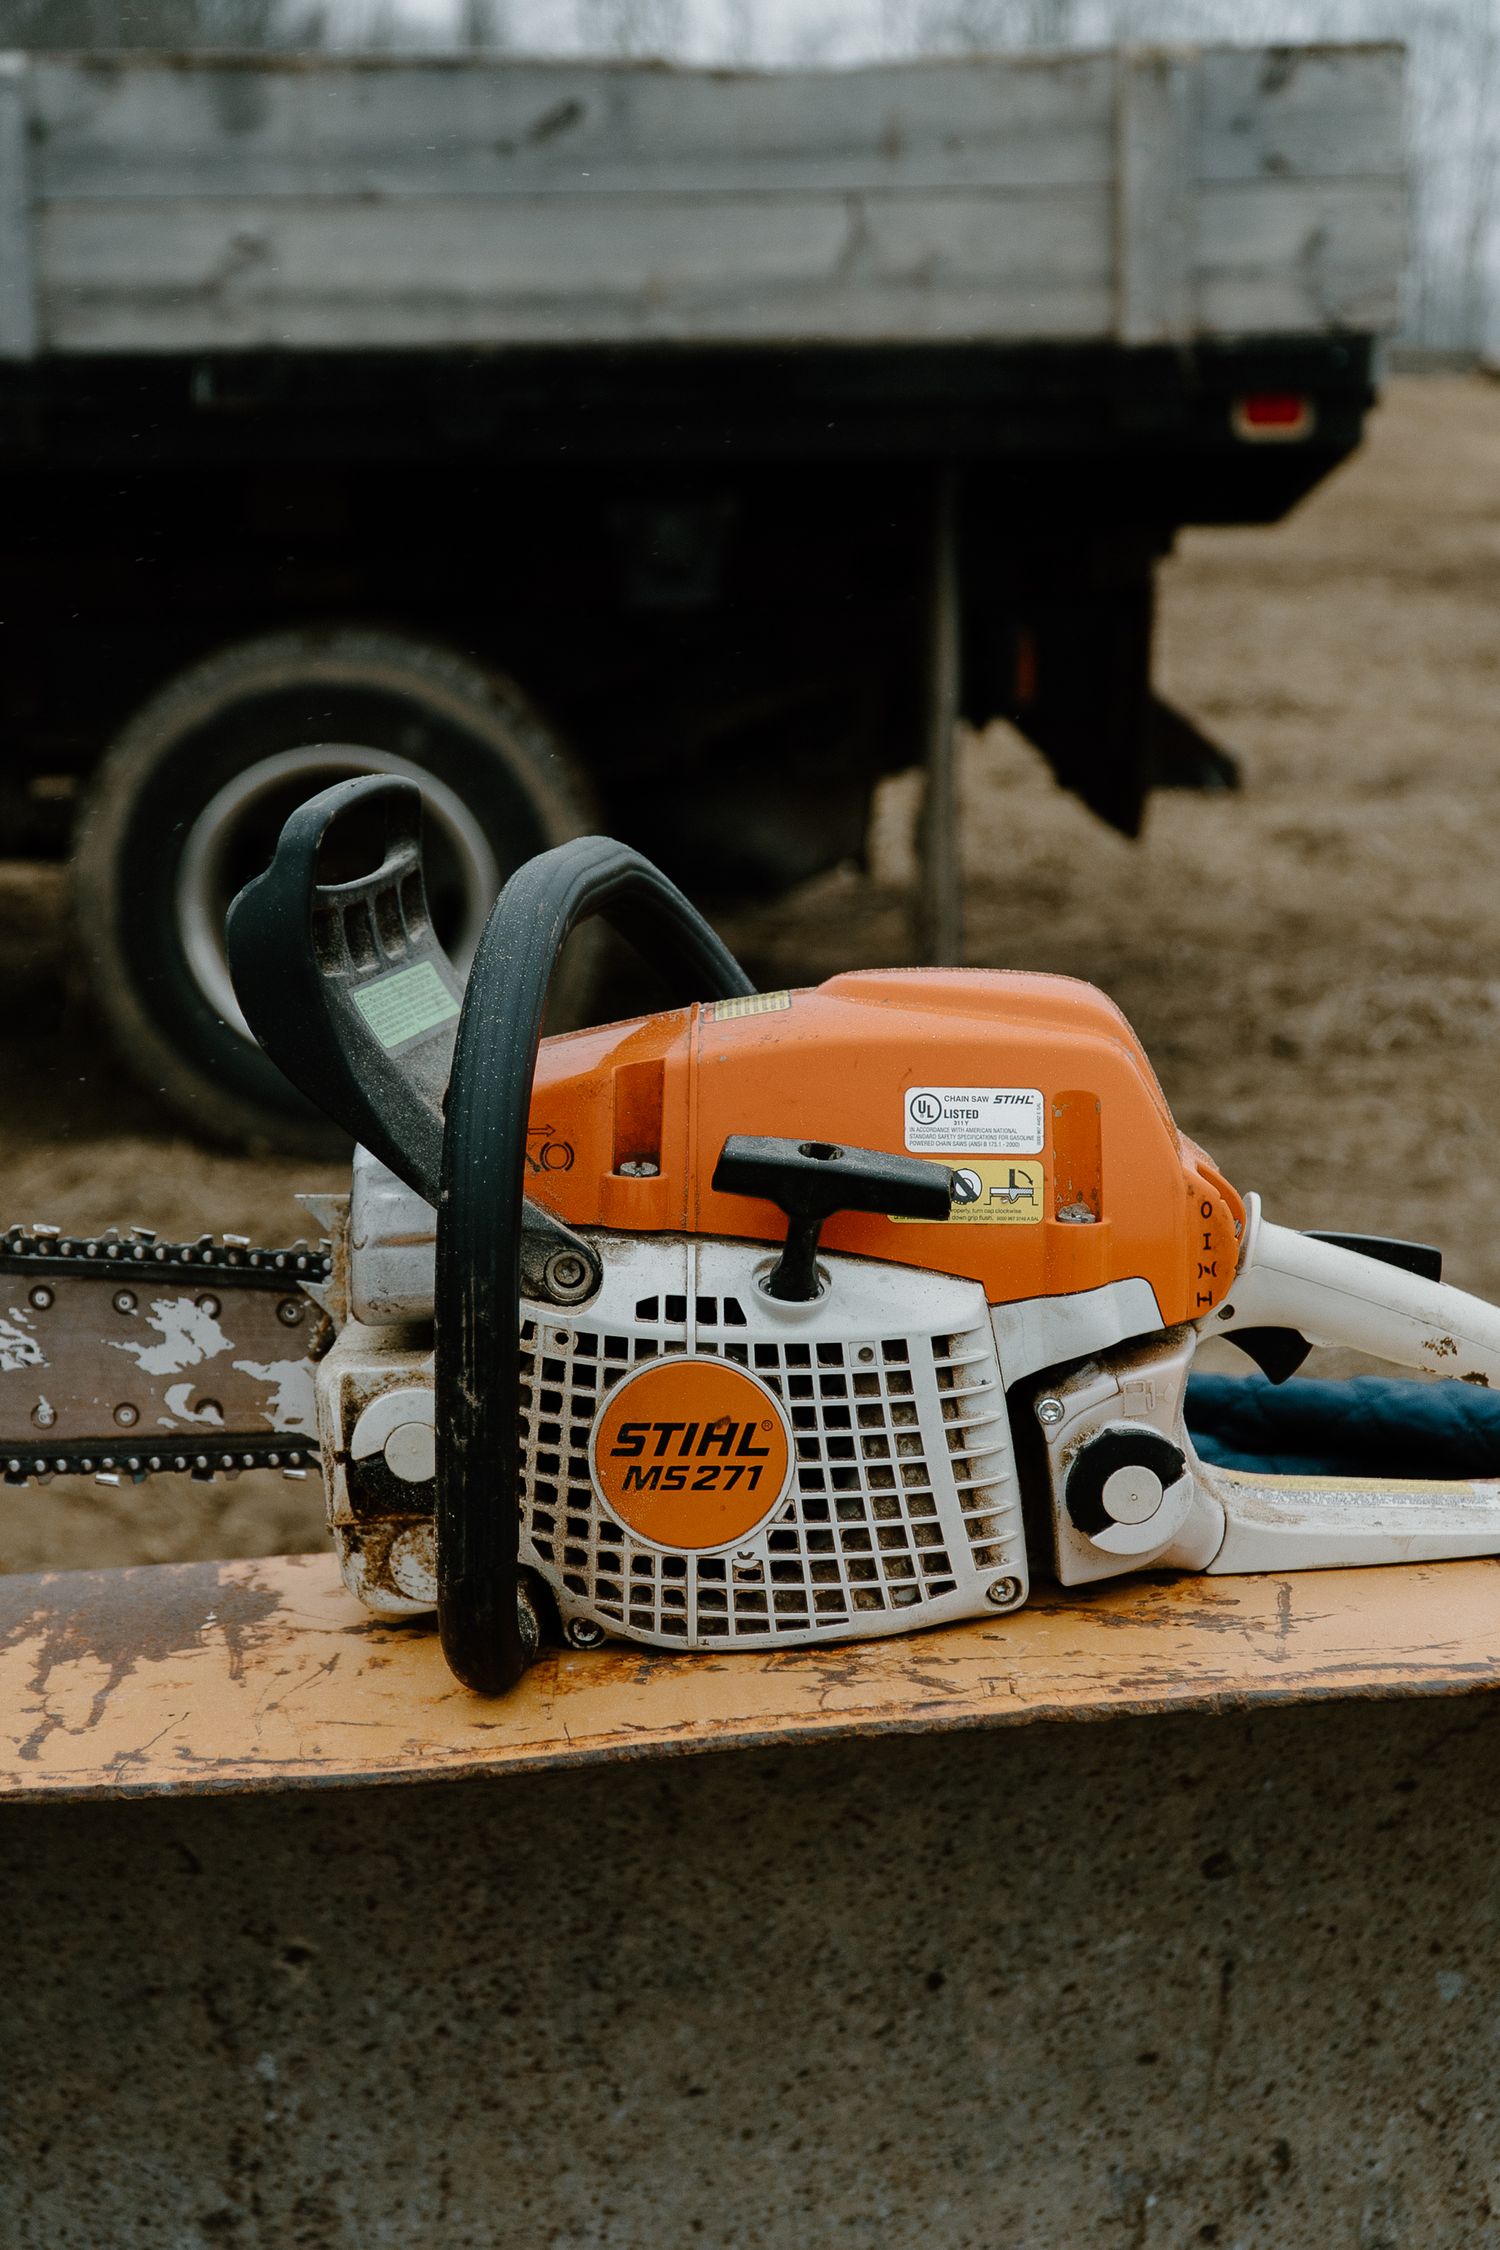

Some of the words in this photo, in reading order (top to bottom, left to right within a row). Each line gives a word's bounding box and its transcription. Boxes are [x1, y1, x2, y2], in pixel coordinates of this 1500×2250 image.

[943, 1095, 970, 1103] CHAIN
[971, 1095, 990, 1103] SAW
[993, 1094, 1034, 1105] STIHL
[943, 1109, 979, 1119] LISTED
[610, 1422, 770, 1457] STIHL
